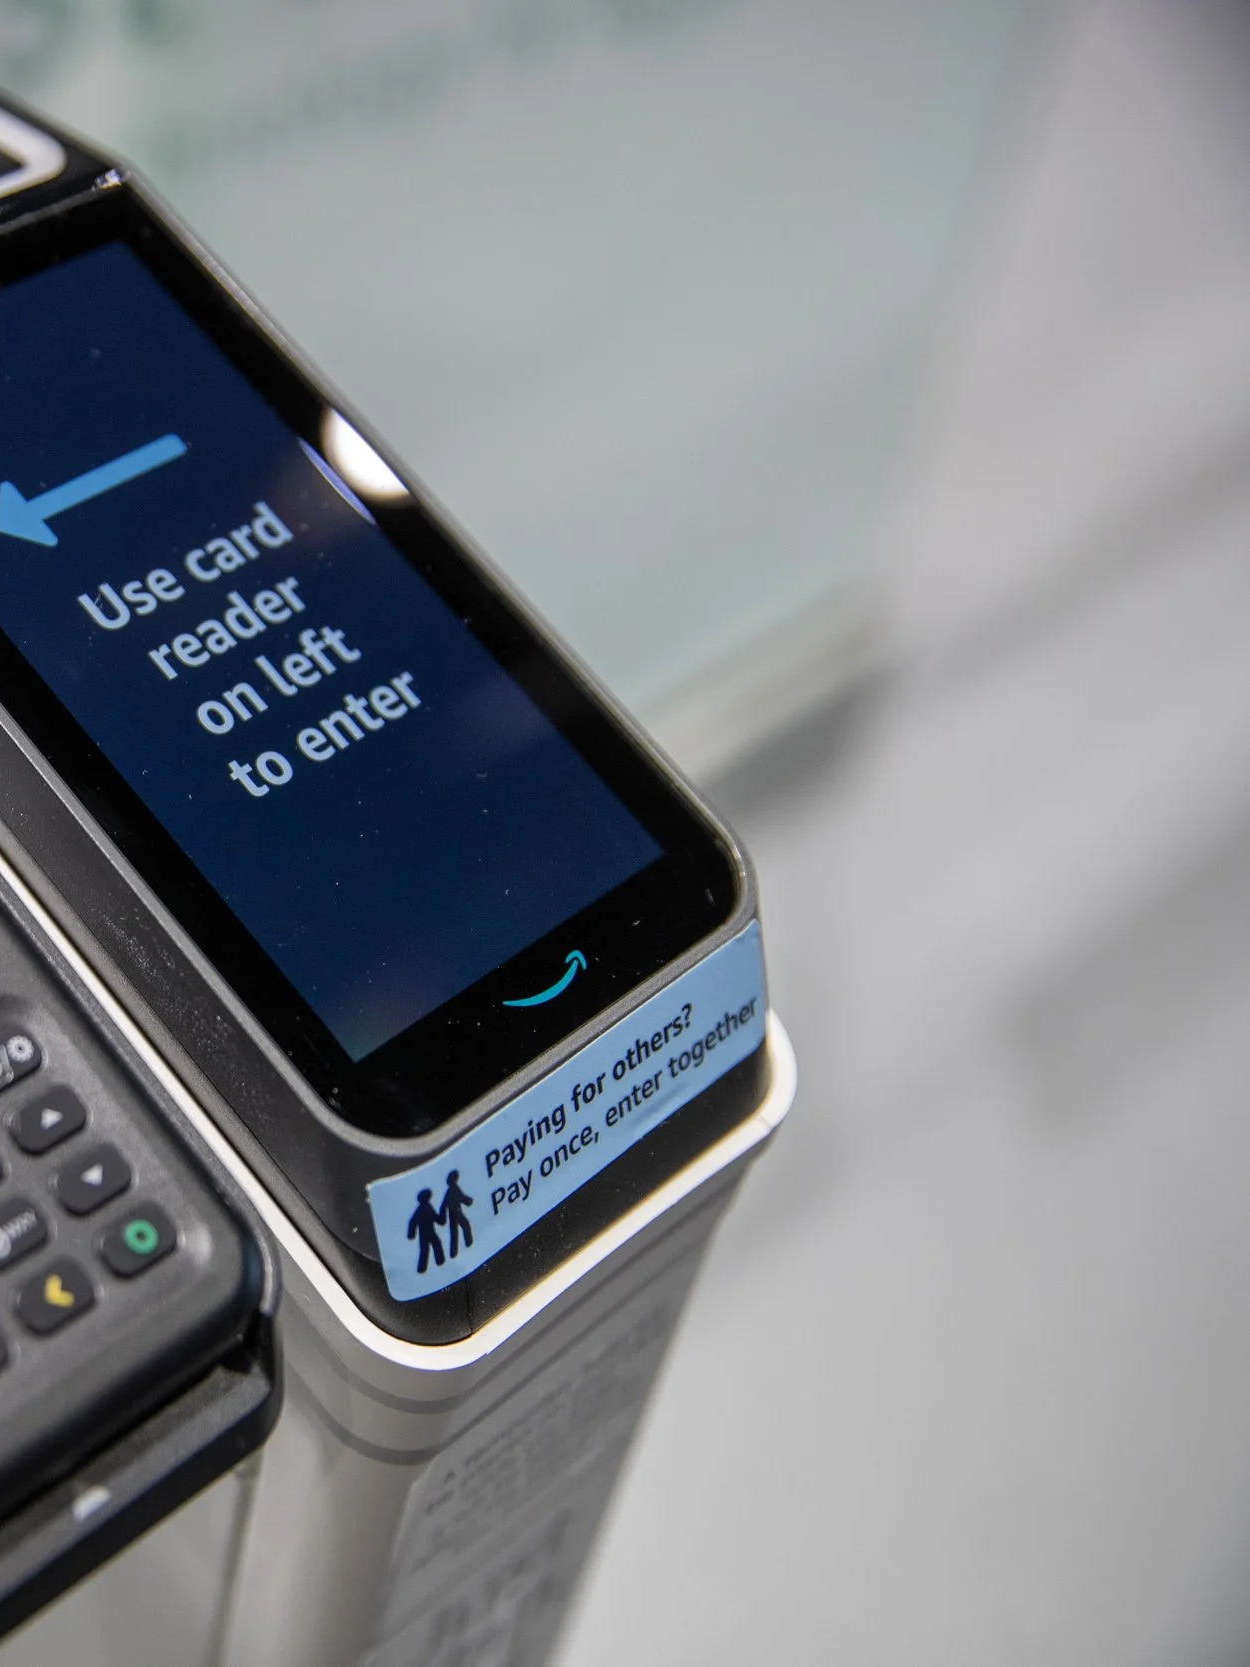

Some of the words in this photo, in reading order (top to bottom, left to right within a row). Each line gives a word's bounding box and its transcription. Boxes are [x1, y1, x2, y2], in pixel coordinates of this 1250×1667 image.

[77, 567, 185, 631] Use
[185, 501, 295, 582] card
[148, 576, 307, 681] reader
[196, 677, 270, 735] on
[255, 625, 362, 697] left
[226, 750, 295, 798] to
[295, 671, 423, 763] enter
[484, 1104, 566, 1178] Paying
[571, 1070, 606, 1114] for
[613, 1002, 693, 1080] others?
[490, 1169, 533, 1216] Pay
[540, 1126, 600, 1177] once,
[605, 1070, 663, 1128] enter
[668, 996, 758, 1080] together
